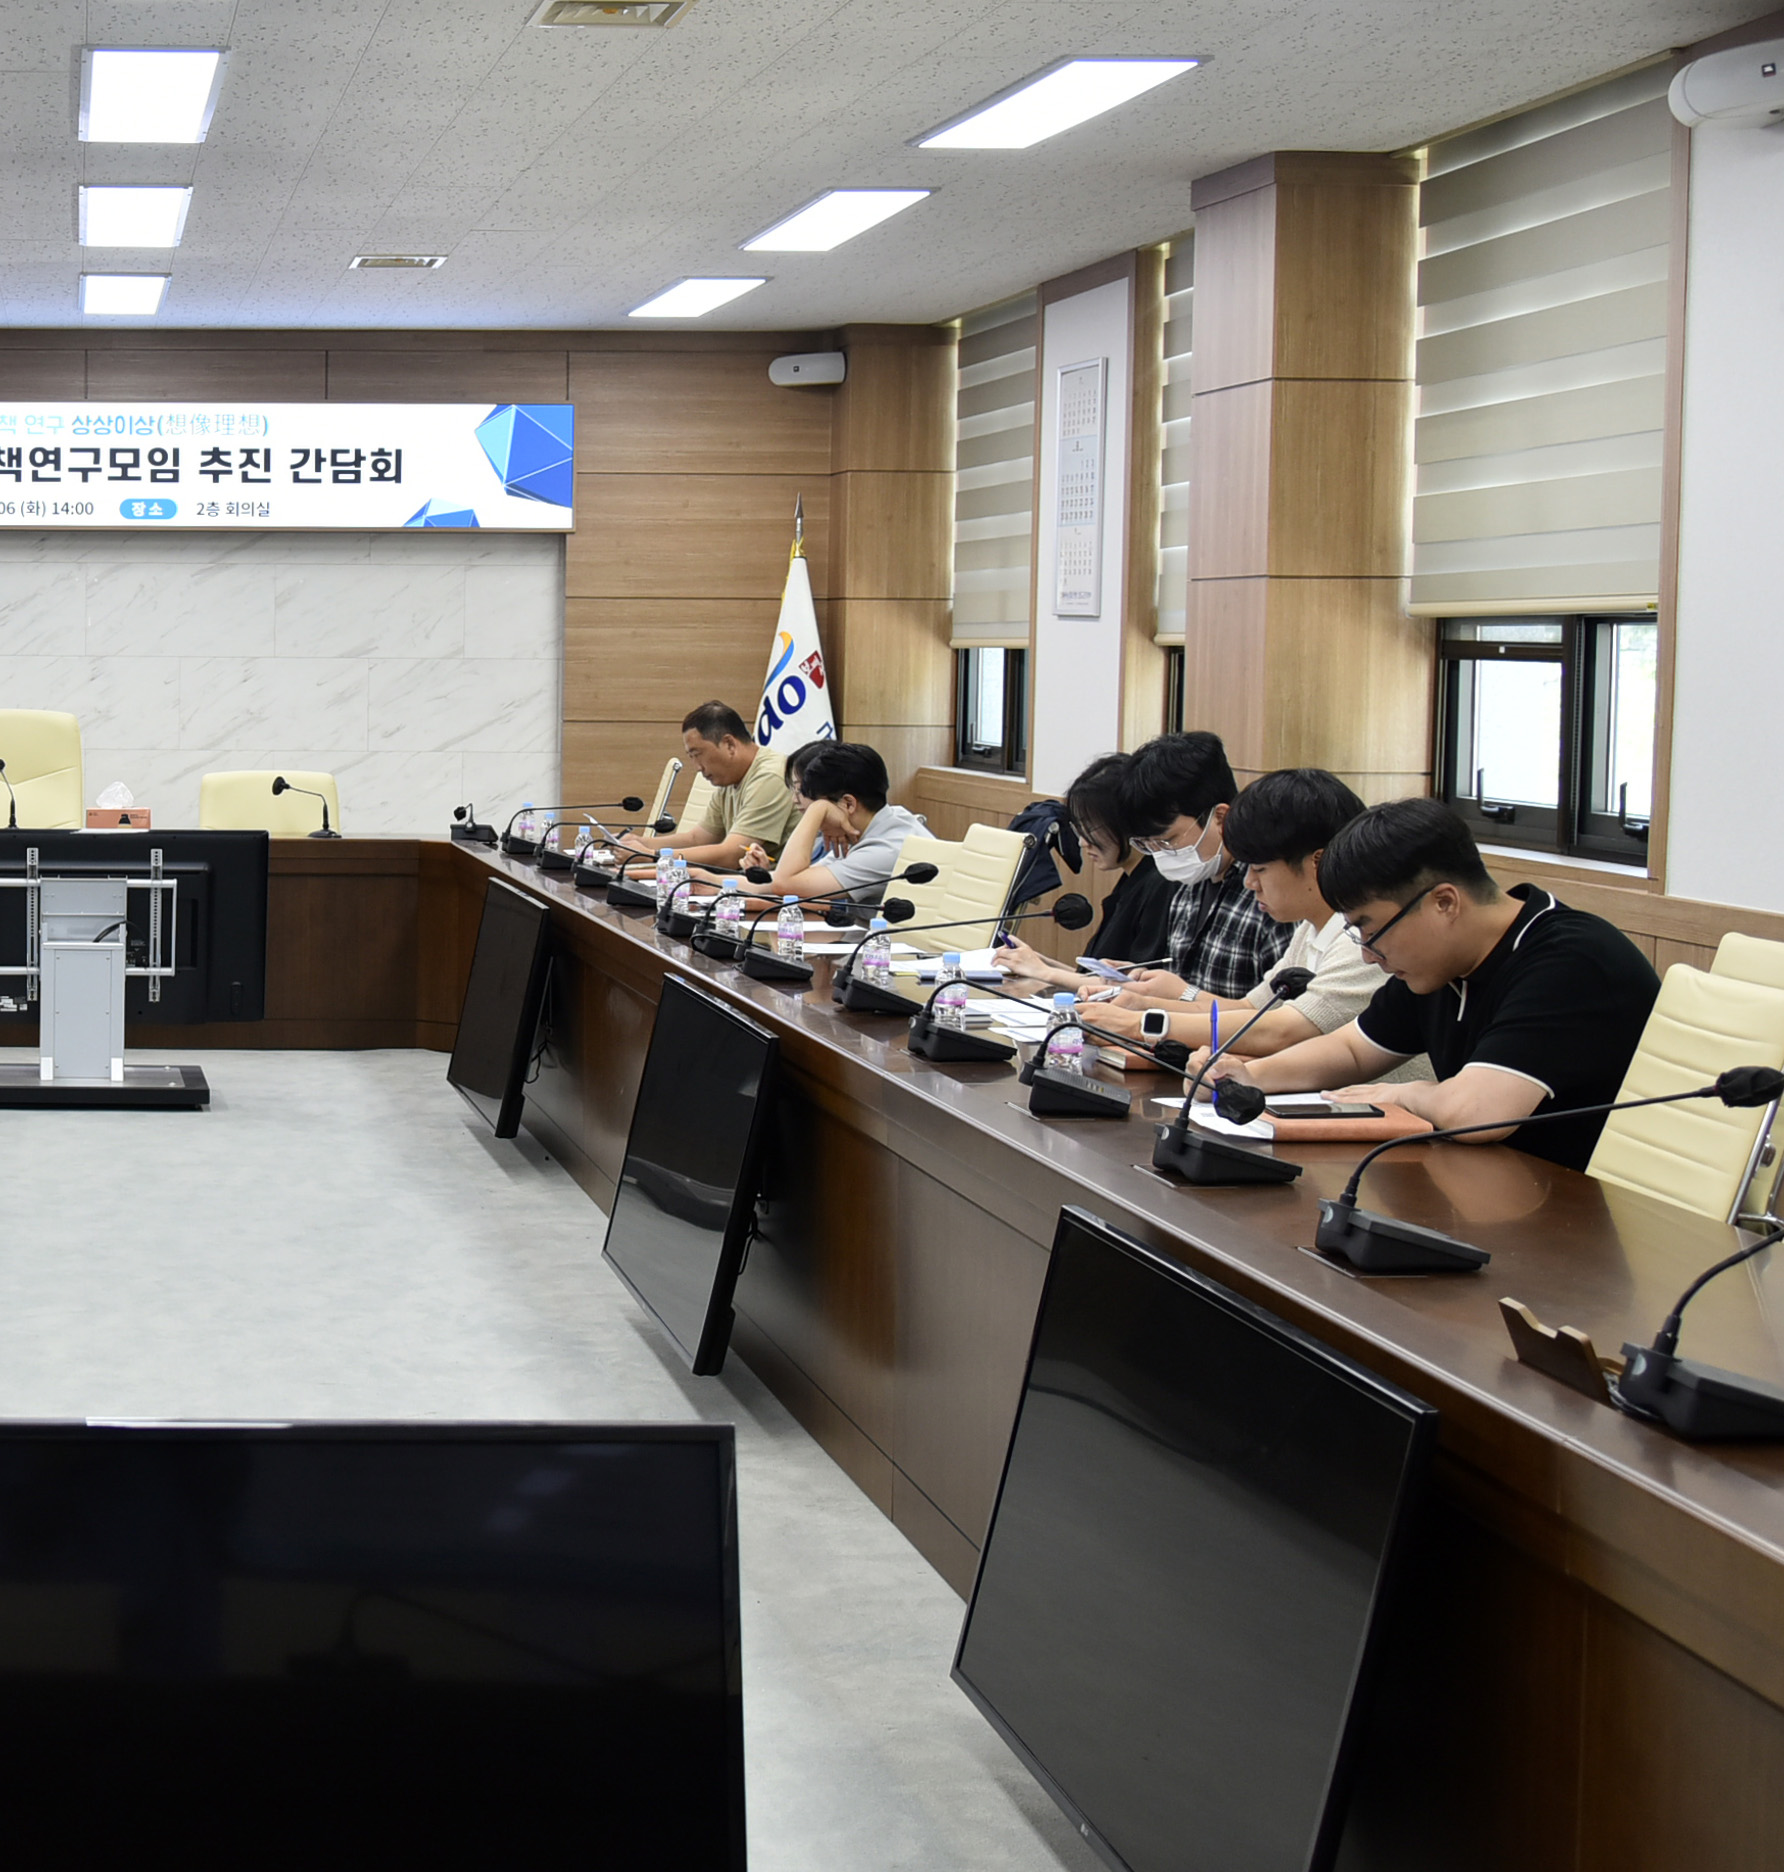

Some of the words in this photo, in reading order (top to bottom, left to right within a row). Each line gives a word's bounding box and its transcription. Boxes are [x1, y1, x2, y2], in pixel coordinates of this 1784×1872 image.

[24, 414, 65, 435] 연구
[198, 446, 272, 484] 추진
[289, 447, 403, 484] 간담회
[20, 500, 46, 518] (화)
[52, 501, 94, 516] 14:00
[196, 501, 220, 518] 2층
[226, 501, 270, 518] 회의실
